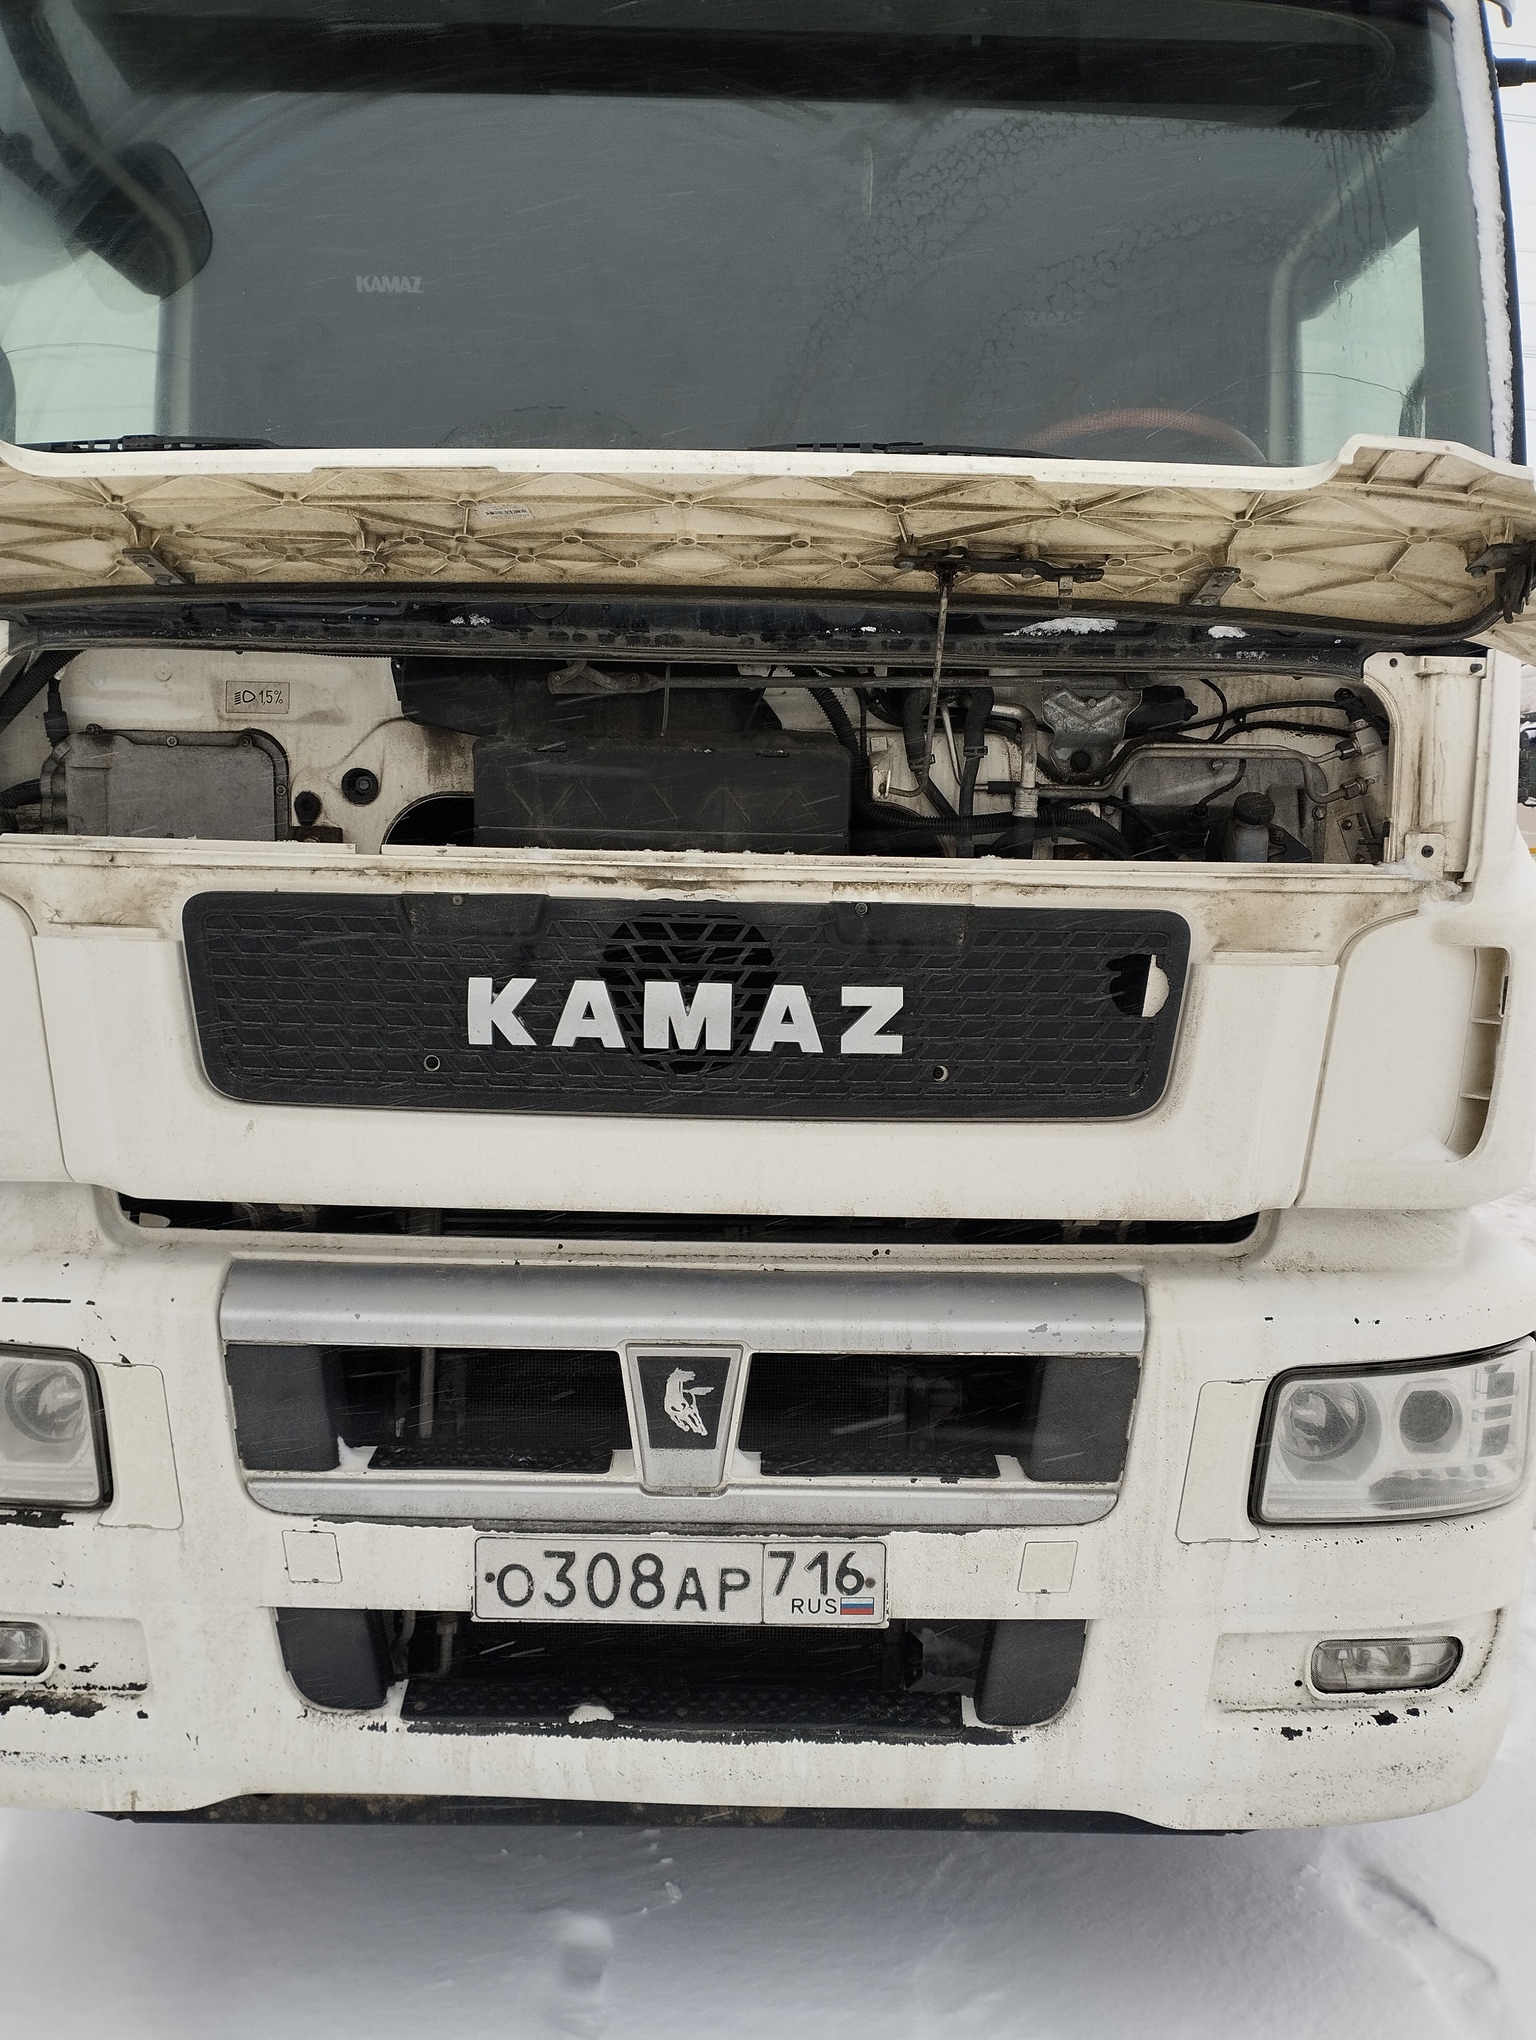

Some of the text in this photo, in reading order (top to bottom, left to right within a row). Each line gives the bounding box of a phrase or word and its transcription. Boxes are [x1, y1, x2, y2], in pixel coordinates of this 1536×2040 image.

[355, 275, 424, 293] KAMAZ
[258, 689, 284, 706] 1,5%
[468, 976, 905, 1054] KAMAZ
[767, 1550, 865, 1596] 716
[790, 1597, 838, 1614] RUS
